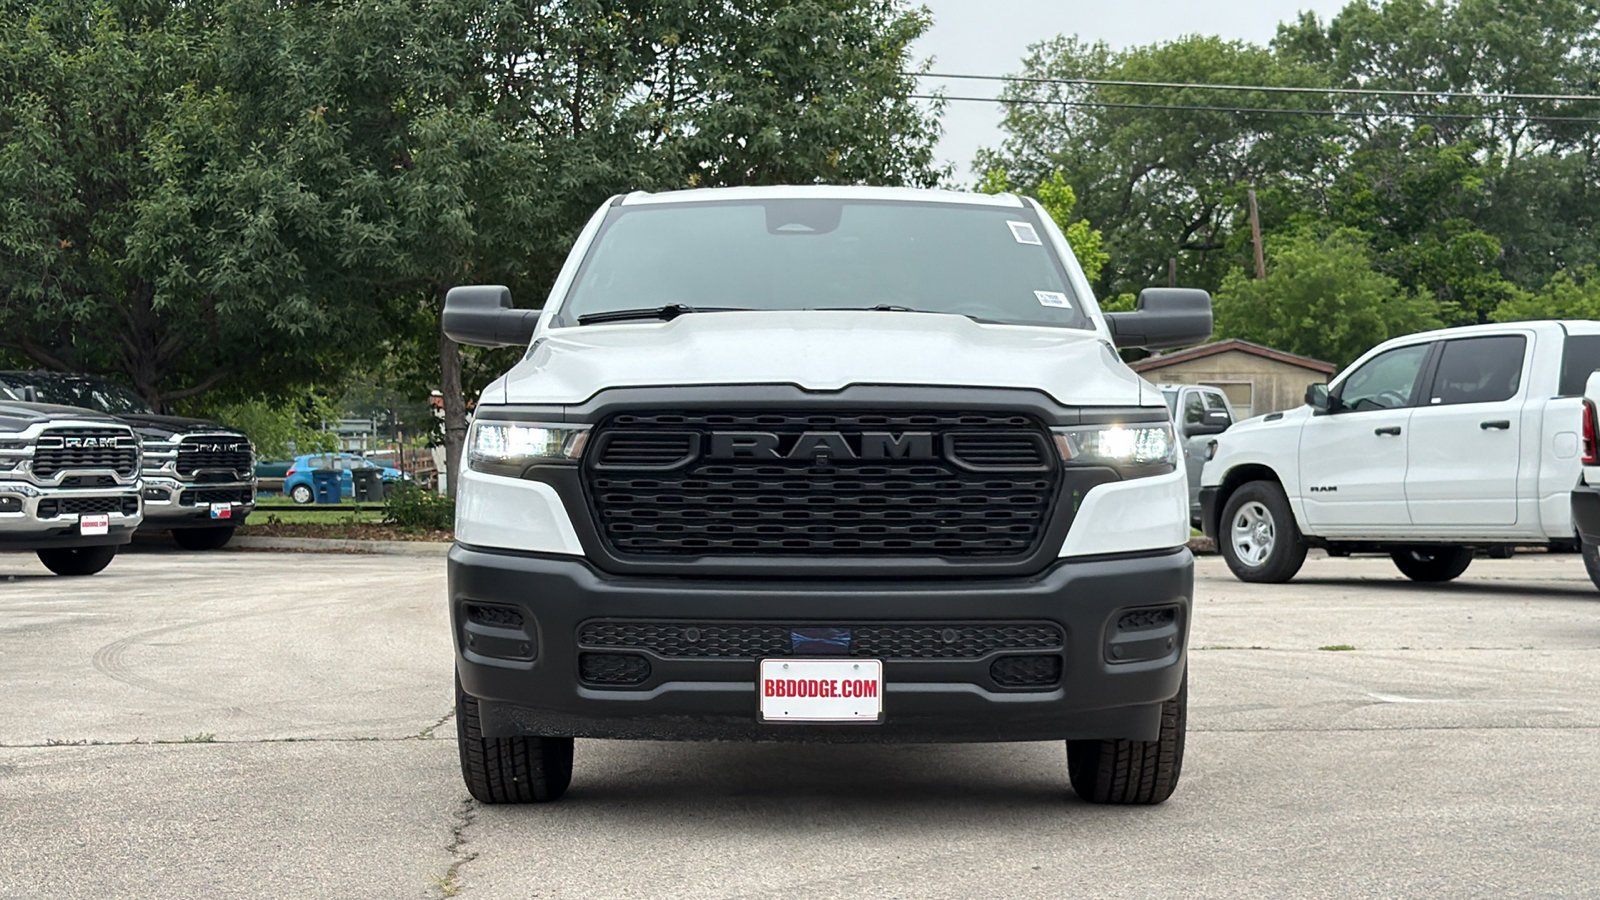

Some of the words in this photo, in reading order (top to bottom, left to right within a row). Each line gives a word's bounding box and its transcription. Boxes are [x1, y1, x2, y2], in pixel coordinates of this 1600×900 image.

[65, 437, 115, 448] RAM
[199, 443, 238, 453] RAM
[711, 431, 932, 459] RAM
[764, 679, 877, 698] BBDODGE.COM
